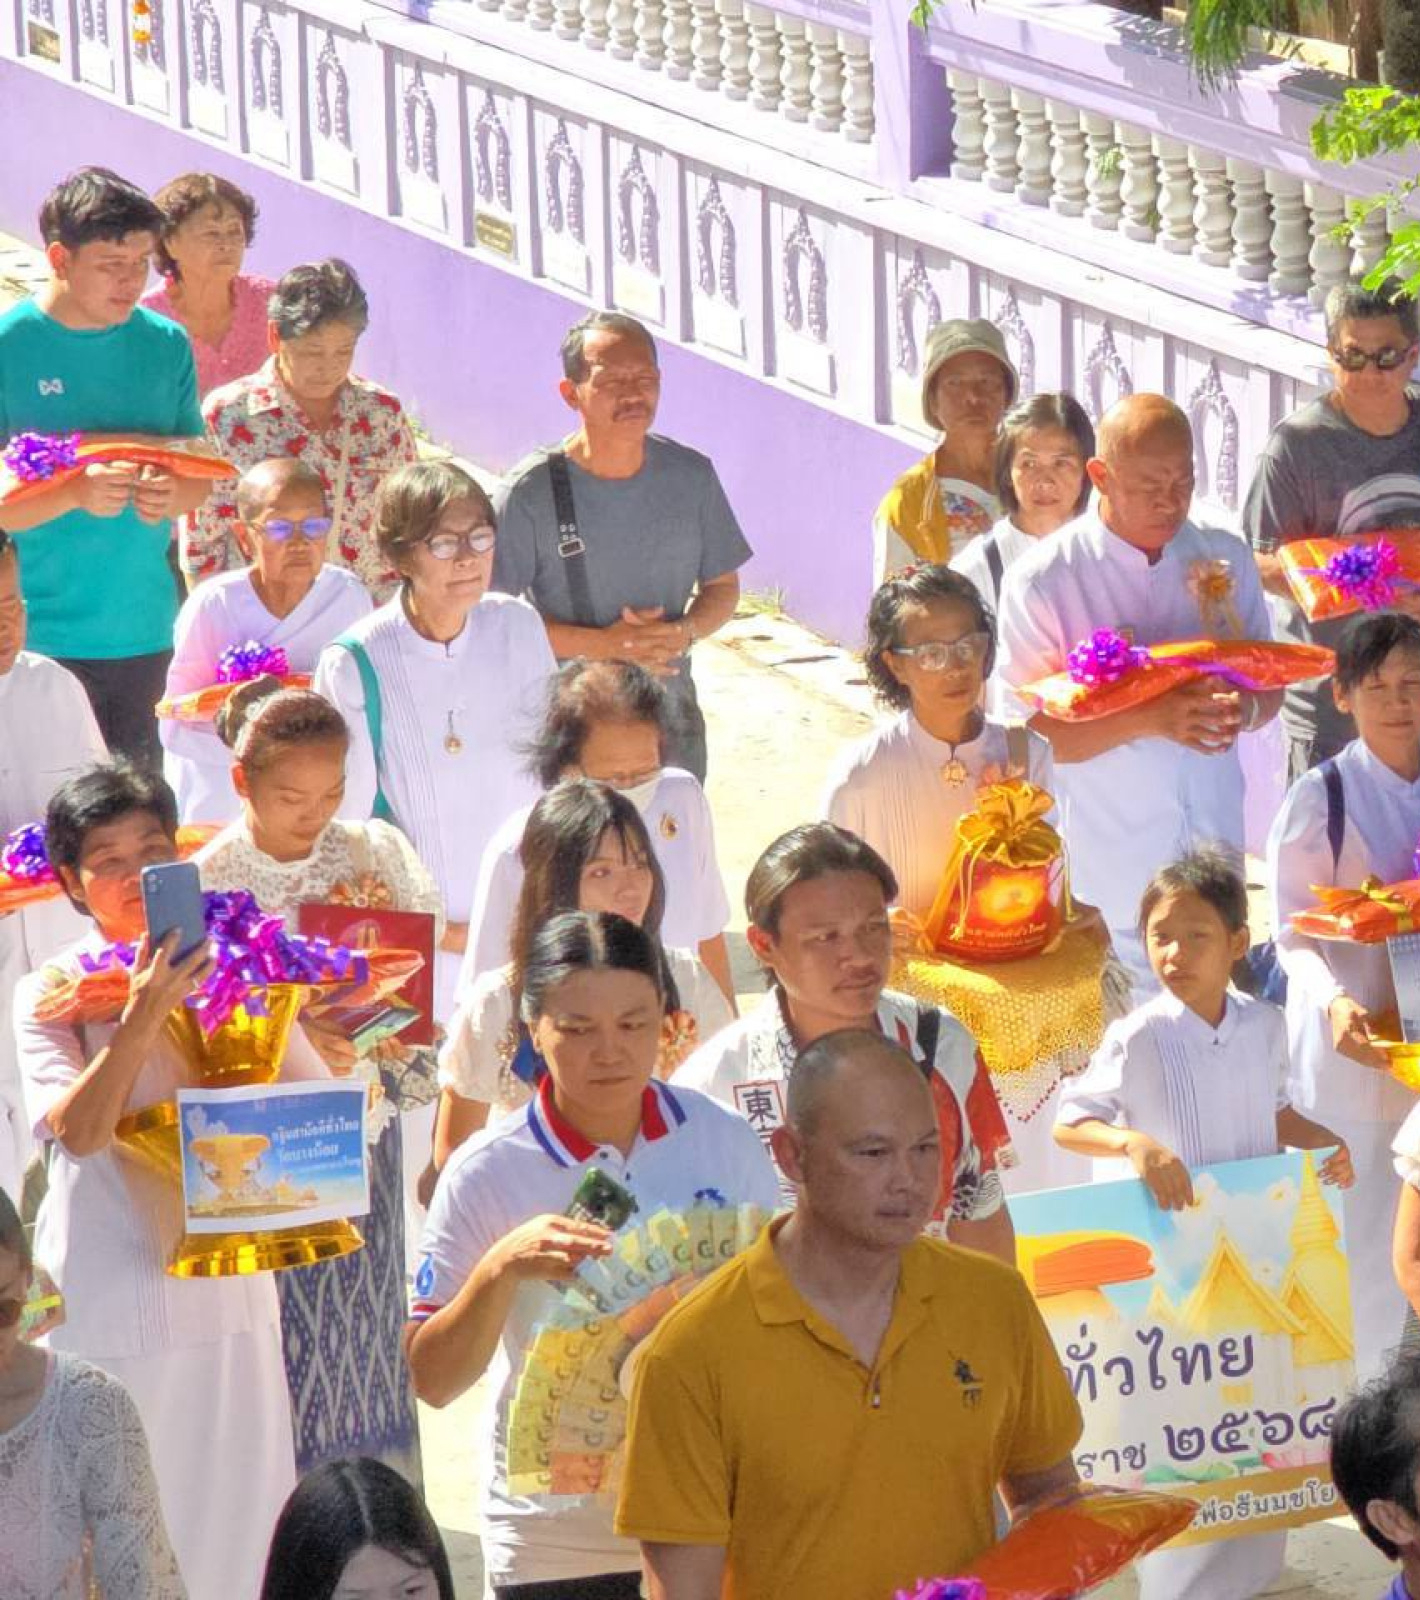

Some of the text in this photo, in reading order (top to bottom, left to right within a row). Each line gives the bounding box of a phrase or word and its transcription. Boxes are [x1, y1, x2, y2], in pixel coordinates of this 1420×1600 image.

[1062, 1322, 1255, 1402] ทั่วไทย
[1162, 1396, 1336, 1462] ๒๕๖๘
